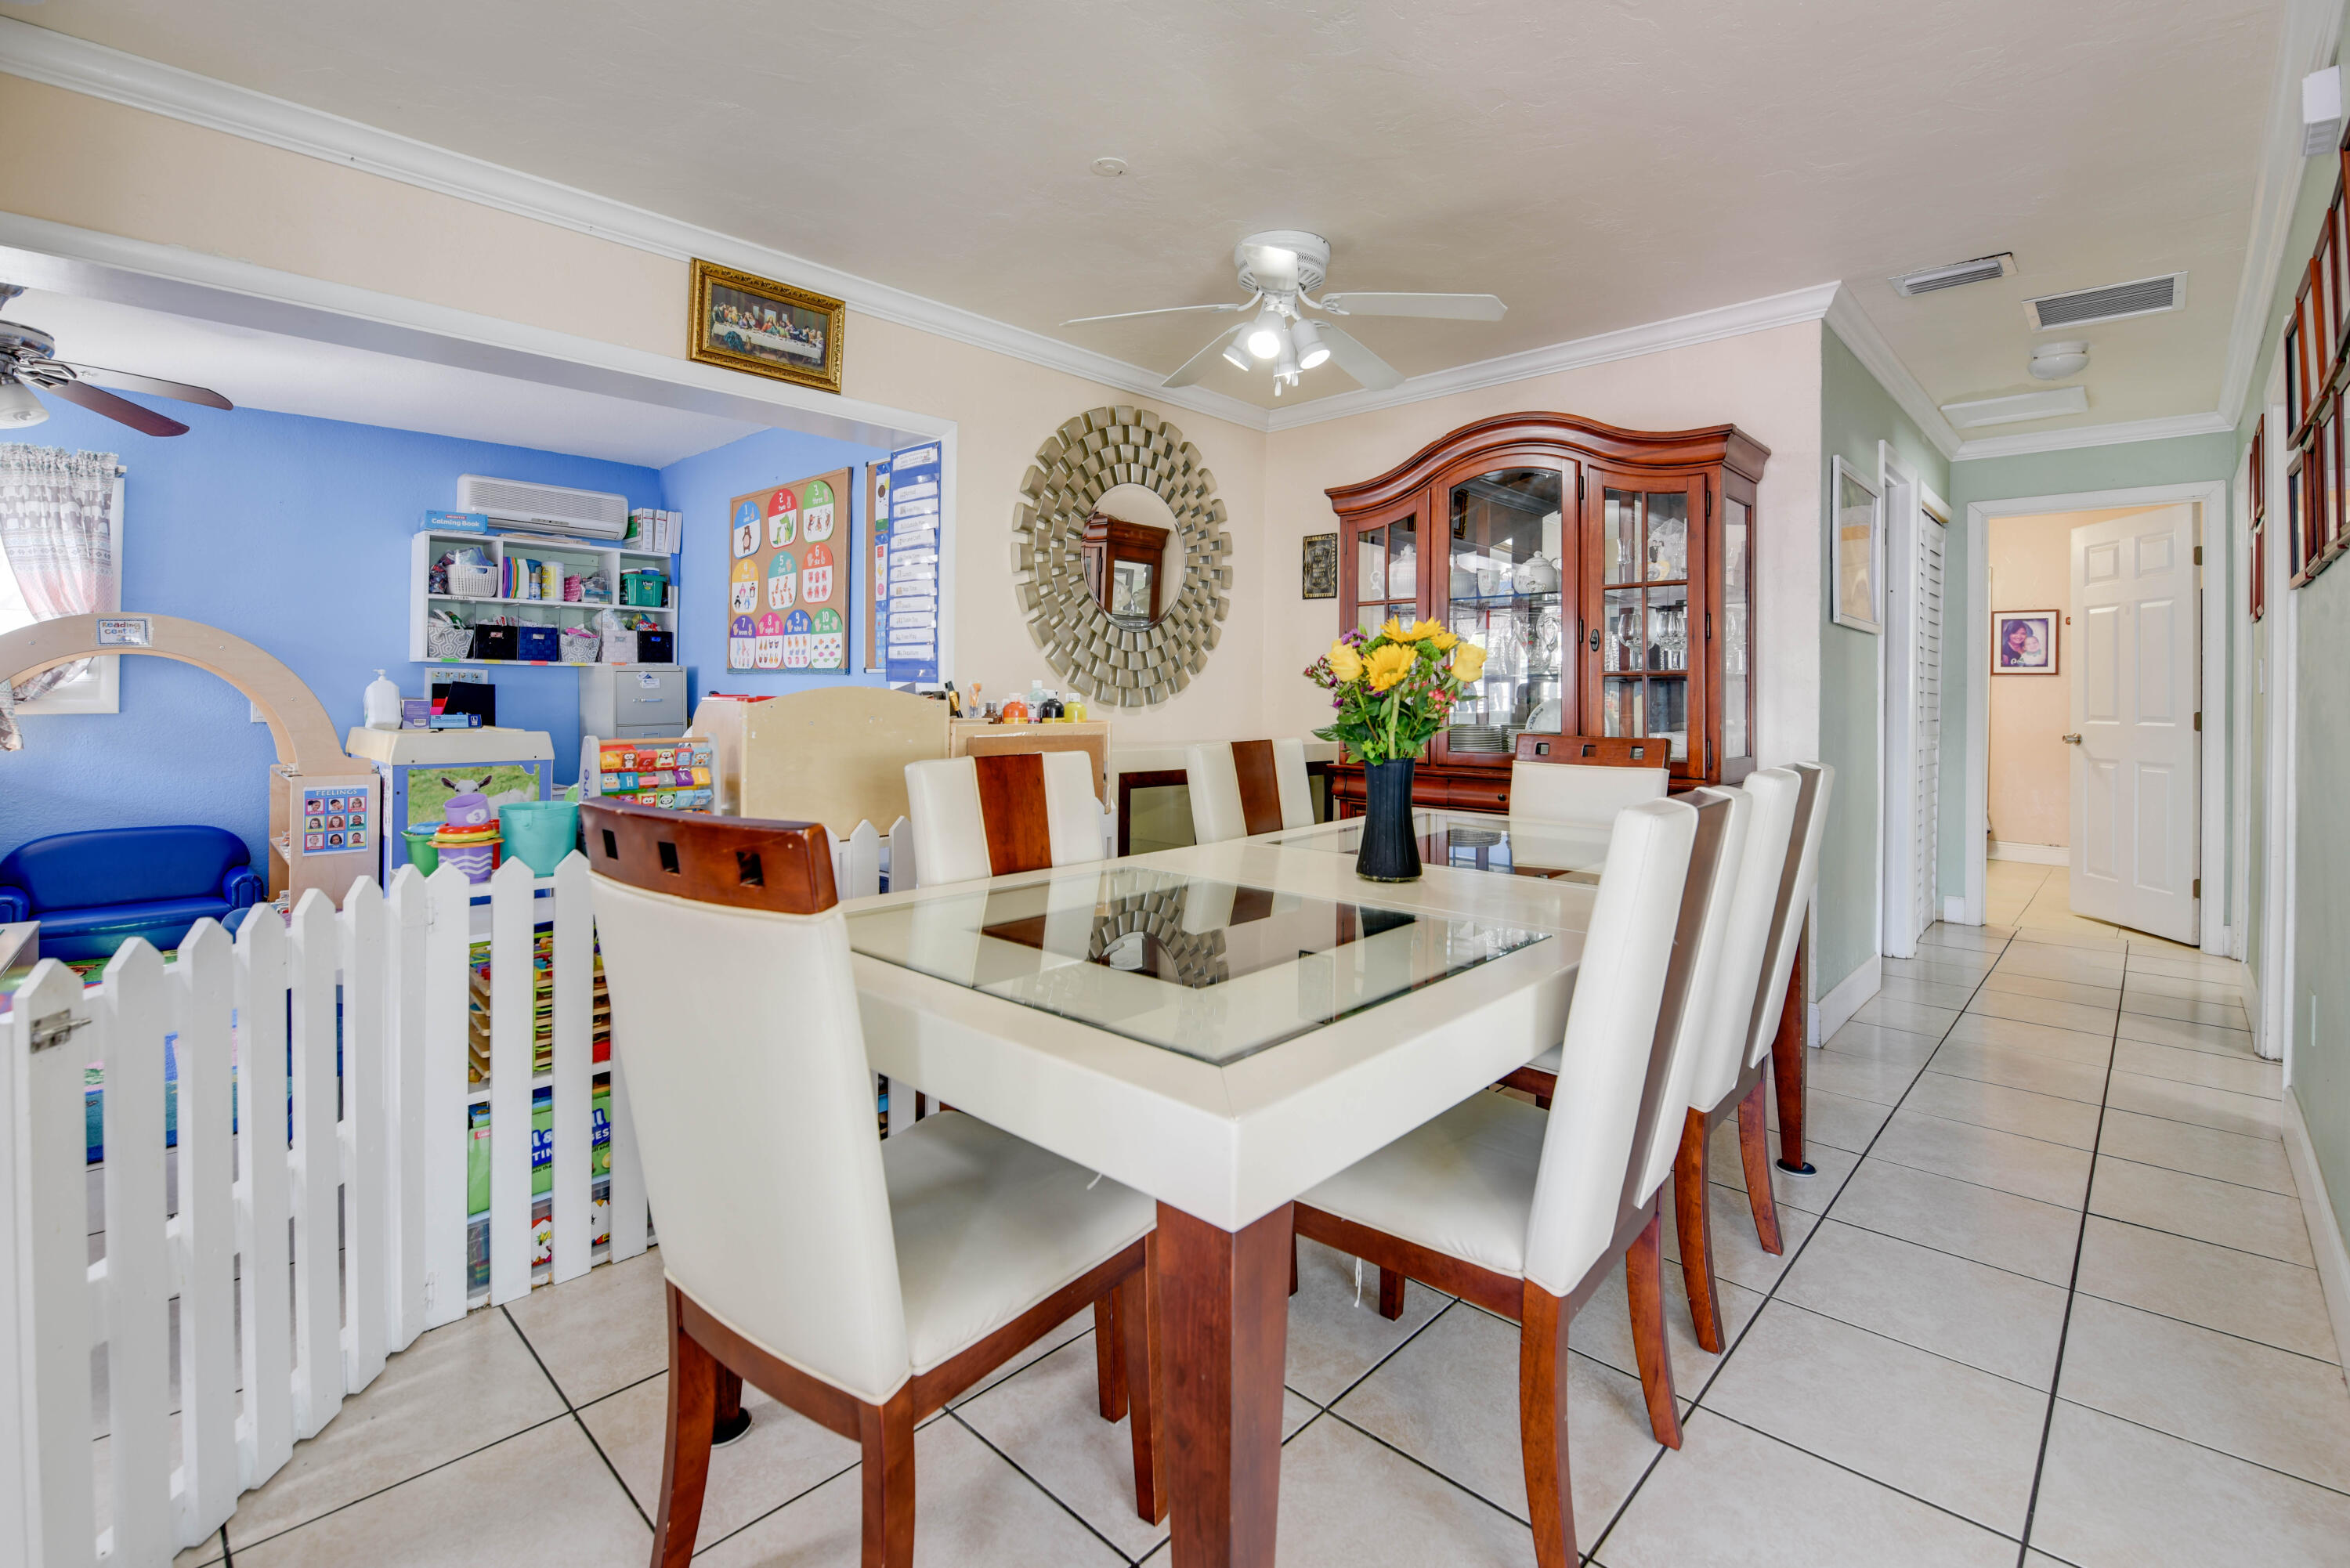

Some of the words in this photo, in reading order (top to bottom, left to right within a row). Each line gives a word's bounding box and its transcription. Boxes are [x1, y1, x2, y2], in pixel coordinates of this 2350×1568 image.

[814, 484, 819, 496] 3
[779, 492, 783, 504] 2
[744, 504, 747, 515] 1
[432, 518, 461, 526] Calming
[815, 544, 819, 556] 6
[779, 555, 784, 565] 5
[741, 617, 746, 628] 7
[768, 615, 772, 626] 8
[795, 612, 800, 624] 9
[822, 611, 830, 623] 10
[627, 776, 634, 787] H
[680, 771, 689, 781] K
[699, 771, 705, 782] L
[473, 812, 481, 822] 3
